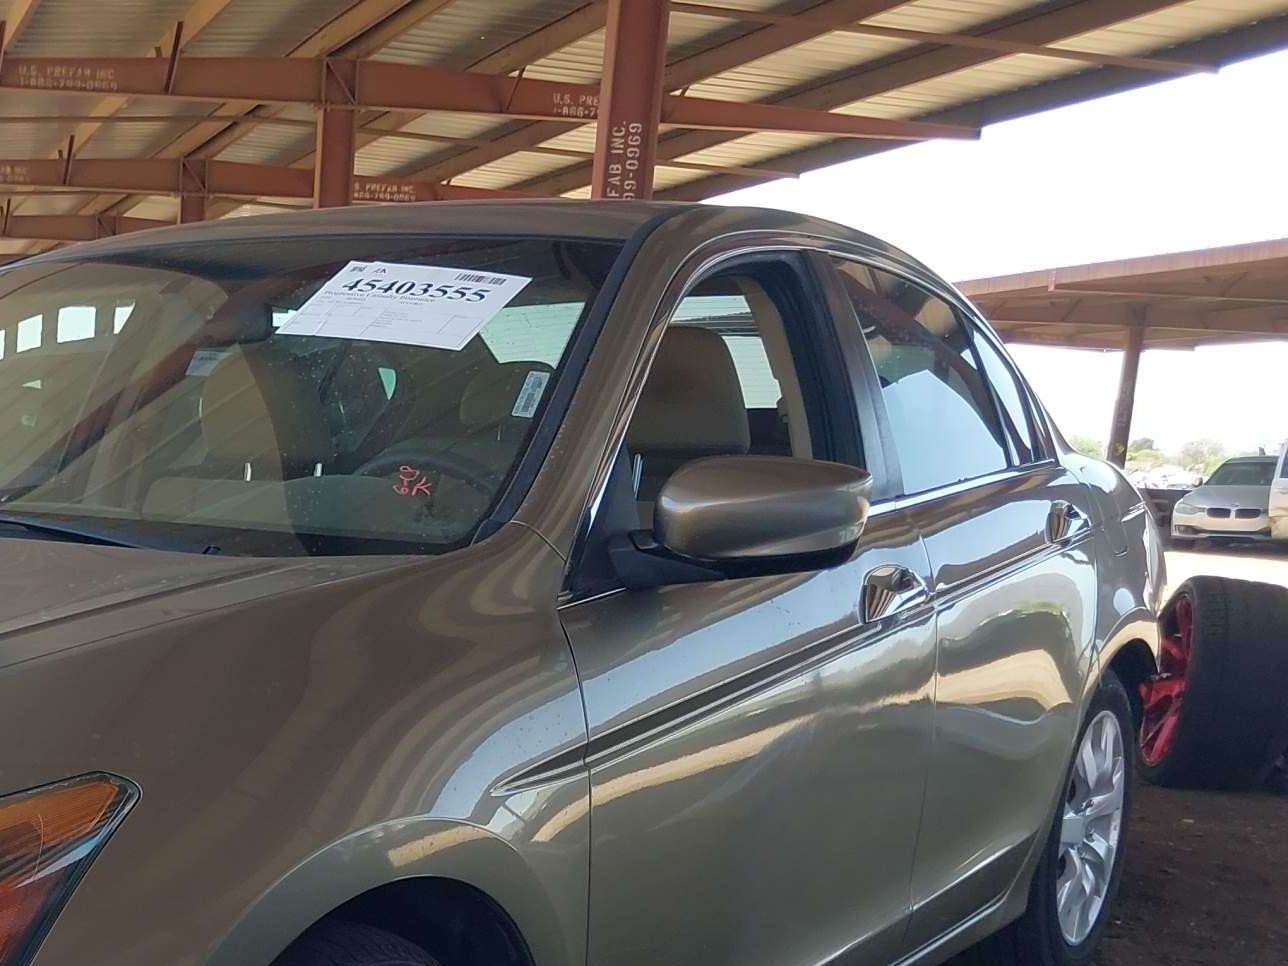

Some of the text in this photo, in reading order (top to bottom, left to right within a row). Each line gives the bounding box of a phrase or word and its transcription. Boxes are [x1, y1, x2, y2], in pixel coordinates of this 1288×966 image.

[553, 92, 574, 105] U.S.
[606, 120, 627, 198] FAB INC.
[342, 278, 491, 303] 45403555
